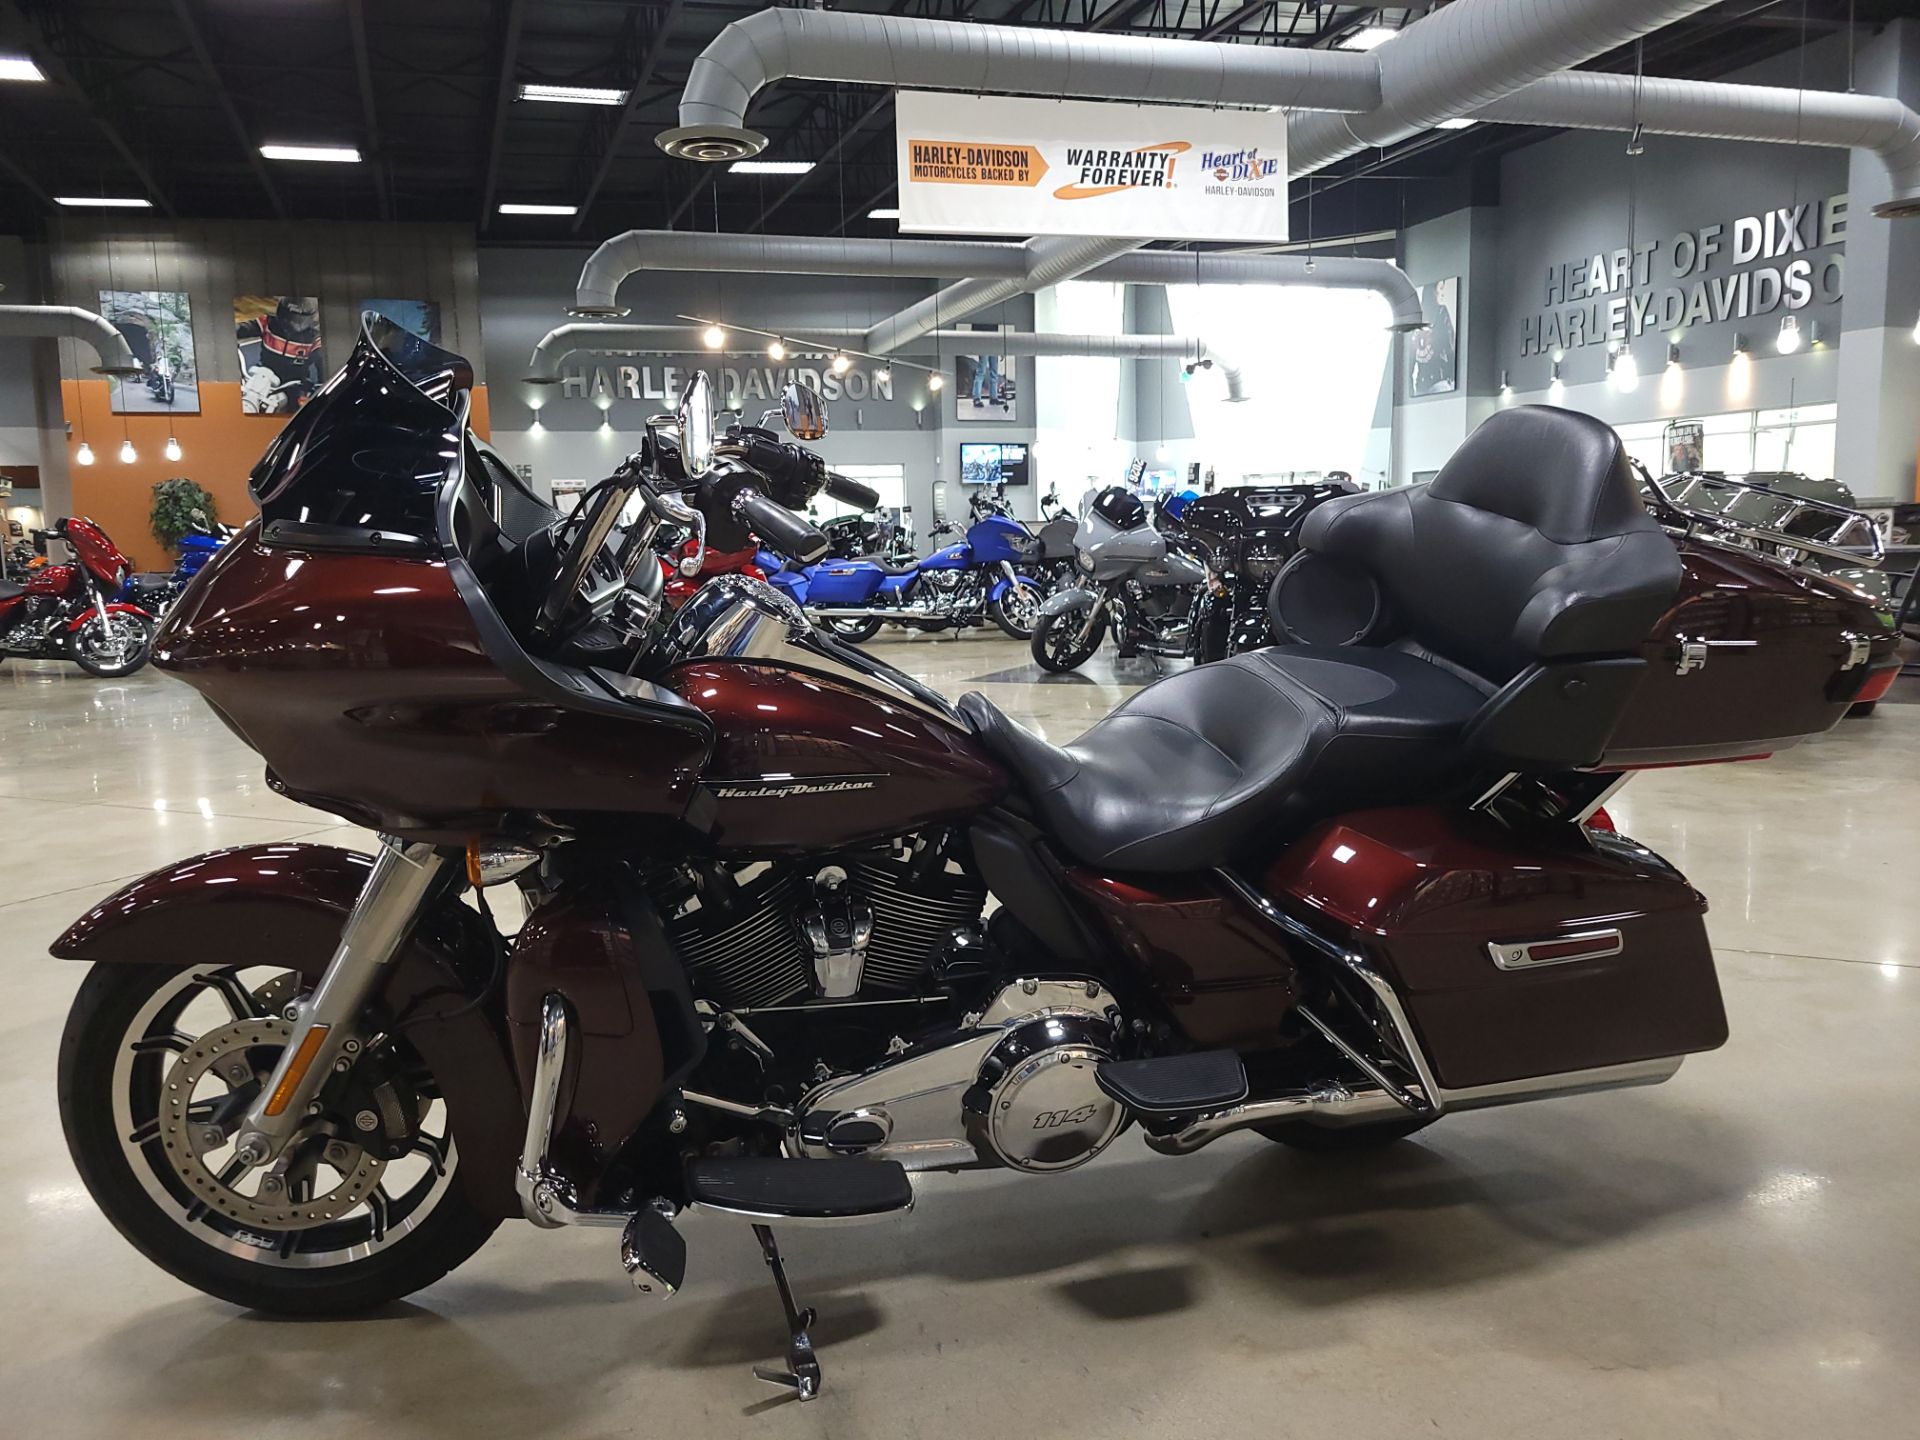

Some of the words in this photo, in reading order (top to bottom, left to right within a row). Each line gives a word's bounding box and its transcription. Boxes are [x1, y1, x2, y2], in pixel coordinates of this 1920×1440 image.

[913, 145, 1028, 168] HARLEY-DAVIDSON
[1067, 148, 1169, 170] WARRANTY
[1201, 149, 1245, 170] Heart
[1247, 147, 1258, 160] of
[914, 164, 977, 180] MOTORCYCLES
[981, 168, 1014, 181] BACKED
[1018, 169, 1029, 182] BY
[1080, 159, 1176, 189] FOREVER!
[1231, 158, 1278, 181] DIXIE
[1205, 186, 1275, 197] HARLEY-DAVIDSON
[1544, 240, 1658, 306] HEART
[1671, 224, 1722, 279] OF
[1732, 193, 1848, 265] DIXIE
[1033, 1104, 1097, 1129] 114
